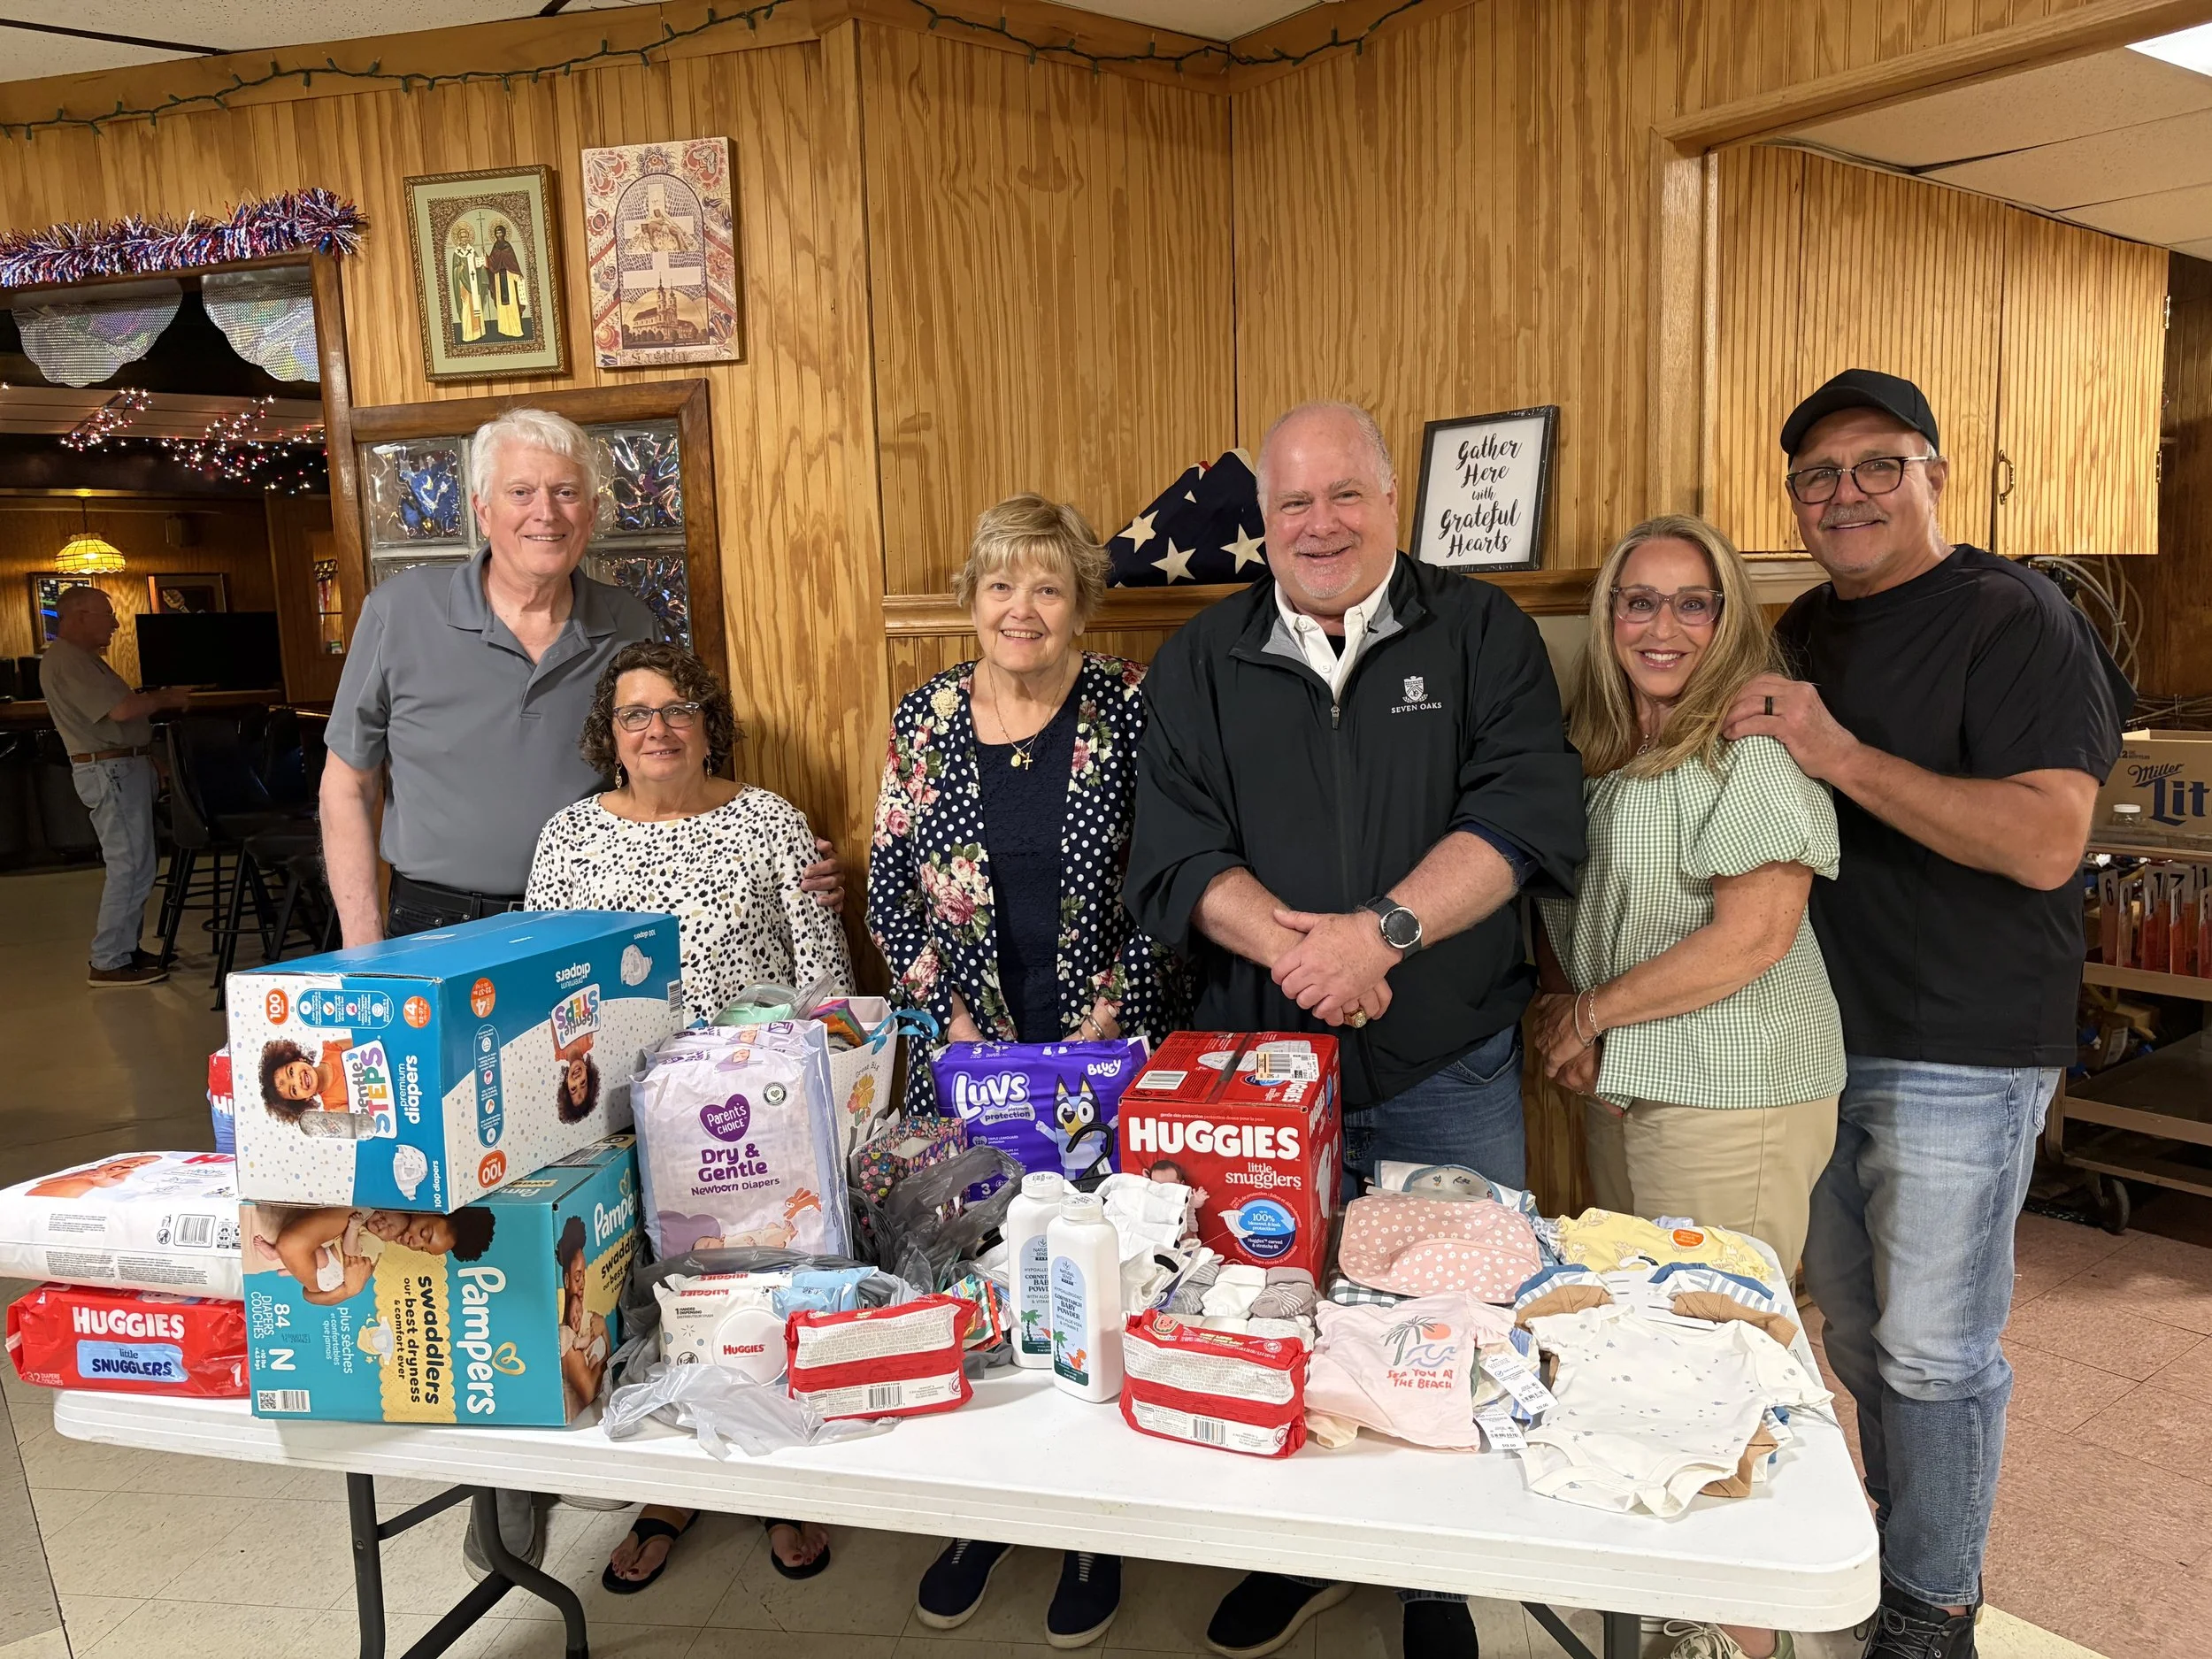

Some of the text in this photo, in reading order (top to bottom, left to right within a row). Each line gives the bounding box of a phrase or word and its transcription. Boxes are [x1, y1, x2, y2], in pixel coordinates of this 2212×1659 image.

[1455, 433, 1524, 471] Gather
[1461, 463, 1510, 488] Here
[1471, 486, 1496, 501] with
[1438, 499, 1522, 540] Grateful
[1446, 528, 1512, 558] Hearts
[1391, 702, 1442, 714] SEVEN OAKS
[2127, 763, 2185, 785] Miller
[2148, 779, 2212, 826] Lit
[2106, 878, 2114, 906] 6
[634, 930, 648, 941] diapers
[555, 962, 591, 984] diapers
[561, 975, 584, 989] premium
[269, 994, 281, 1019] 100
[403, 1002, 418, 1016] 4
[475, 998, 487, 1016] 4
[554, 989, 598, 1030] STEPS
[564, 1012, 595, 1036] Gentle
[871, 1062, 880, 1072] Big
[360, 1047, 391, 1134] STEPS
[397, 1063, 409, 1107] premium
[403, 1055, 423, 1125] diapers
[707, 1102, 747, 1127] Parent's
[985, 1110, 1031, 1122] protection
[717, 1118, 745, 1135] CHOICE
[1128, 1117, 1301, 1161] HUGGIES
[701, 1143, 761, 1166] Dry &
[434, 1160, 443, 1191] diapers
[482, 1161, 503, 1184] 100
[698, 1160, 768, 1183] Gentle
[1248, 1162, 1272, 1173] little
[691, 1178, 780, 1196] Newborn Diapers
[981, 1183, 991, 1194] 3
[1225, 1171, 1302, 1189] snugglers
[1252, 1213, 1276, 1222] 100%
[602, 1234, 636, 1279] swaddl
[610, 1267, 624, 1285] best
[1060, 1268, 1074, 1279] NATURAL
[1054, 1286, 1083, 1301] HYPOALLERGENIC
[1055, 1293, 1083, 1309] CORNSTARCH
[250, 1291, 265, 1340] COUCHES
[262, 1295, 274, 1336] DIAPERS
[273, 1303, 291, 1329] 84
[405, 1298, 418, 1333] best
[1057, 1306, 1081, 1320] POWDER
[1061, 1301, 1076, 1311] BABY
[72, 1305, 185, 1340] HUGGIES
[394, 1308, 403, 1352] comfort
[321, 1320, 333, 1360] que jamais
[330, 1319, 341, 1366] confortables
[337, 1307, 355, 1374] plus sèches
[418, 1275, 444, 1405] swaddlers
[456, 1265, 507, 1415] Pampers
[723, 1344, 764, 1356] HUGGIES
[119, 1348, 139, 1359] little
[268, 1348, 296, 1371] N
[27, 1371, 42, 1383] 32
[92, 1358, 173, 1377] SNUGGLERS
[230, 1363, 243, 1387] 1
[406, 1338, 420, 1403] dryness
[1411, 1369, 1437, 1379] YOU
[1443, 1369, 1454, 1379] AT
[41, 1378, 64, 1386] COUCHES
[1394, 1379, 1452, 1389] THE BEACH
